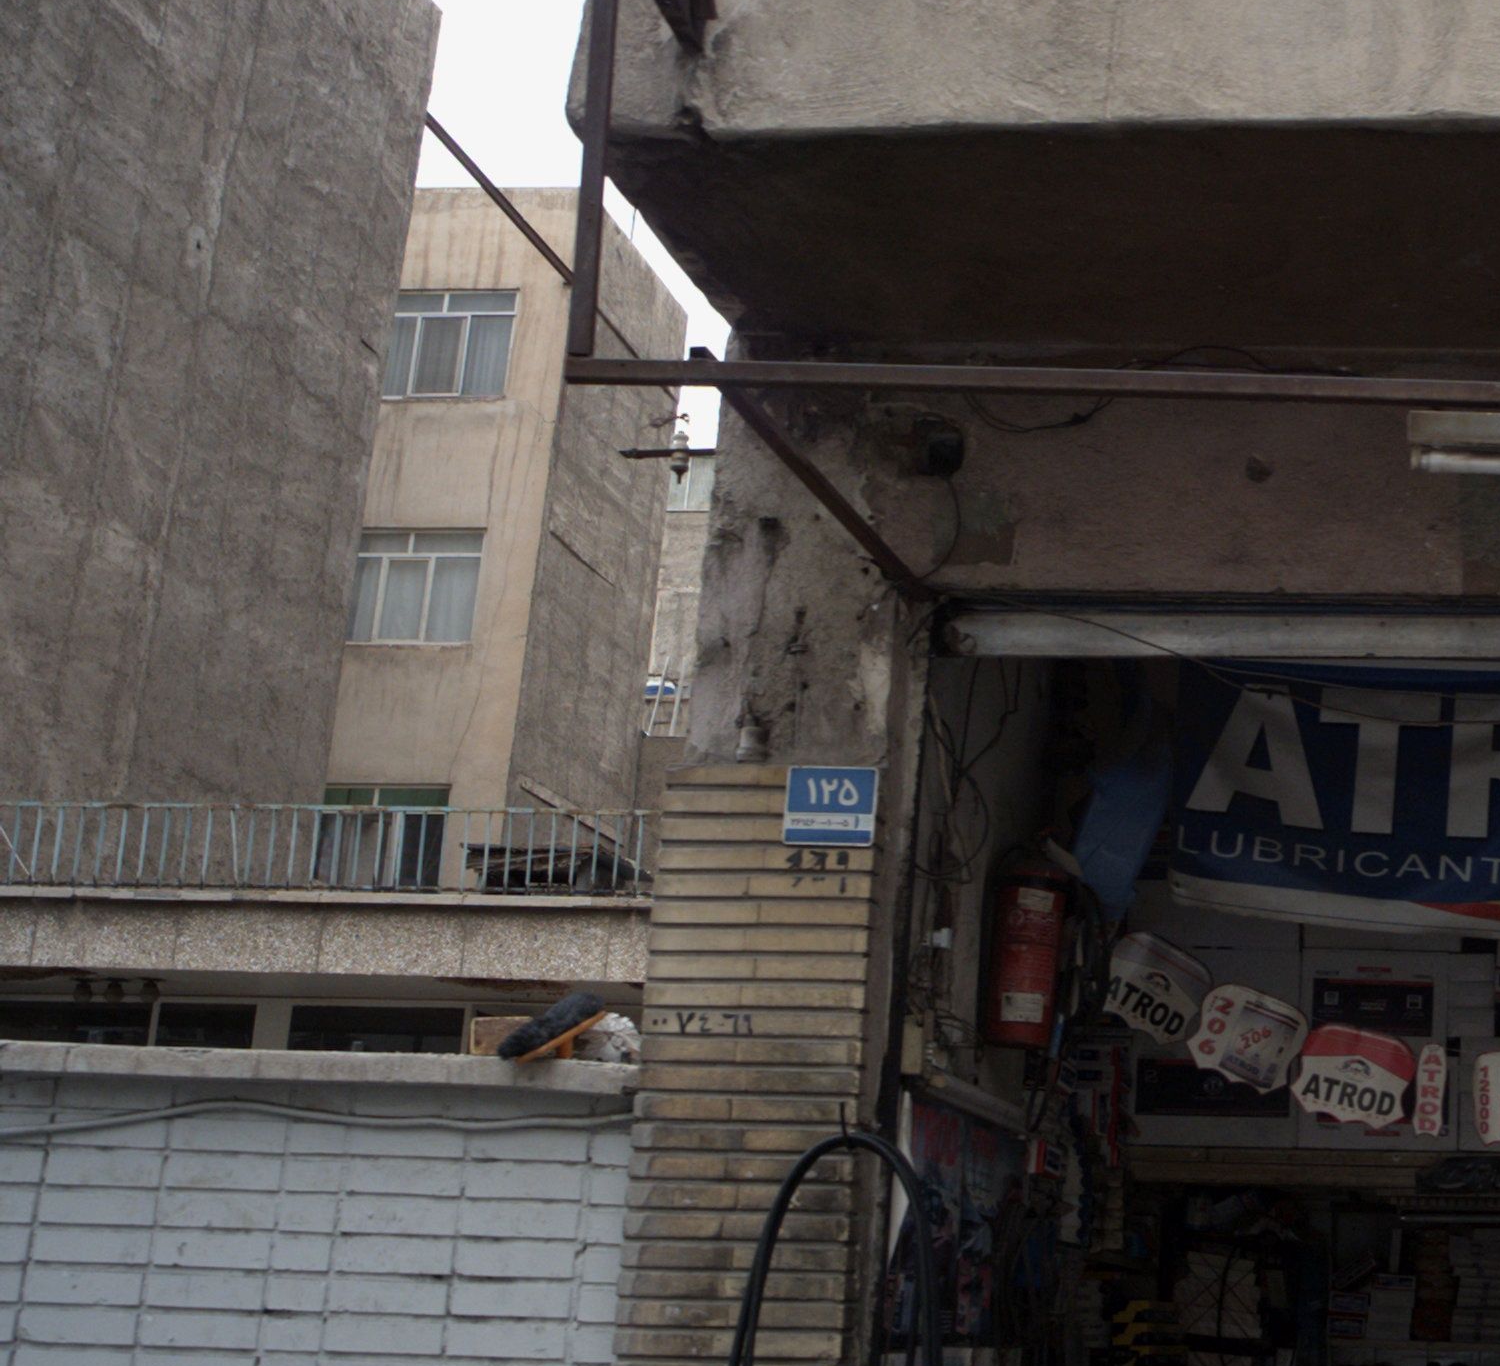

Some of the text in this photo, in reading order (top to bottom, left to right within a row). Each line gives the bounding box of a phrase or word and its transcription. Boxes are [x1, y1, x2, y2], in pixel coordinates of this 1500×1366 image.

[806, 776, 860, 807] ۱۲۵
[1106, 975, 1185, 1036] ATROD
[1300, 1073, 1397, 1117] ATROD
[1417, 1053, 1441, 1131] ATROD
[1478, 1065, 1490, 1135] 12000
